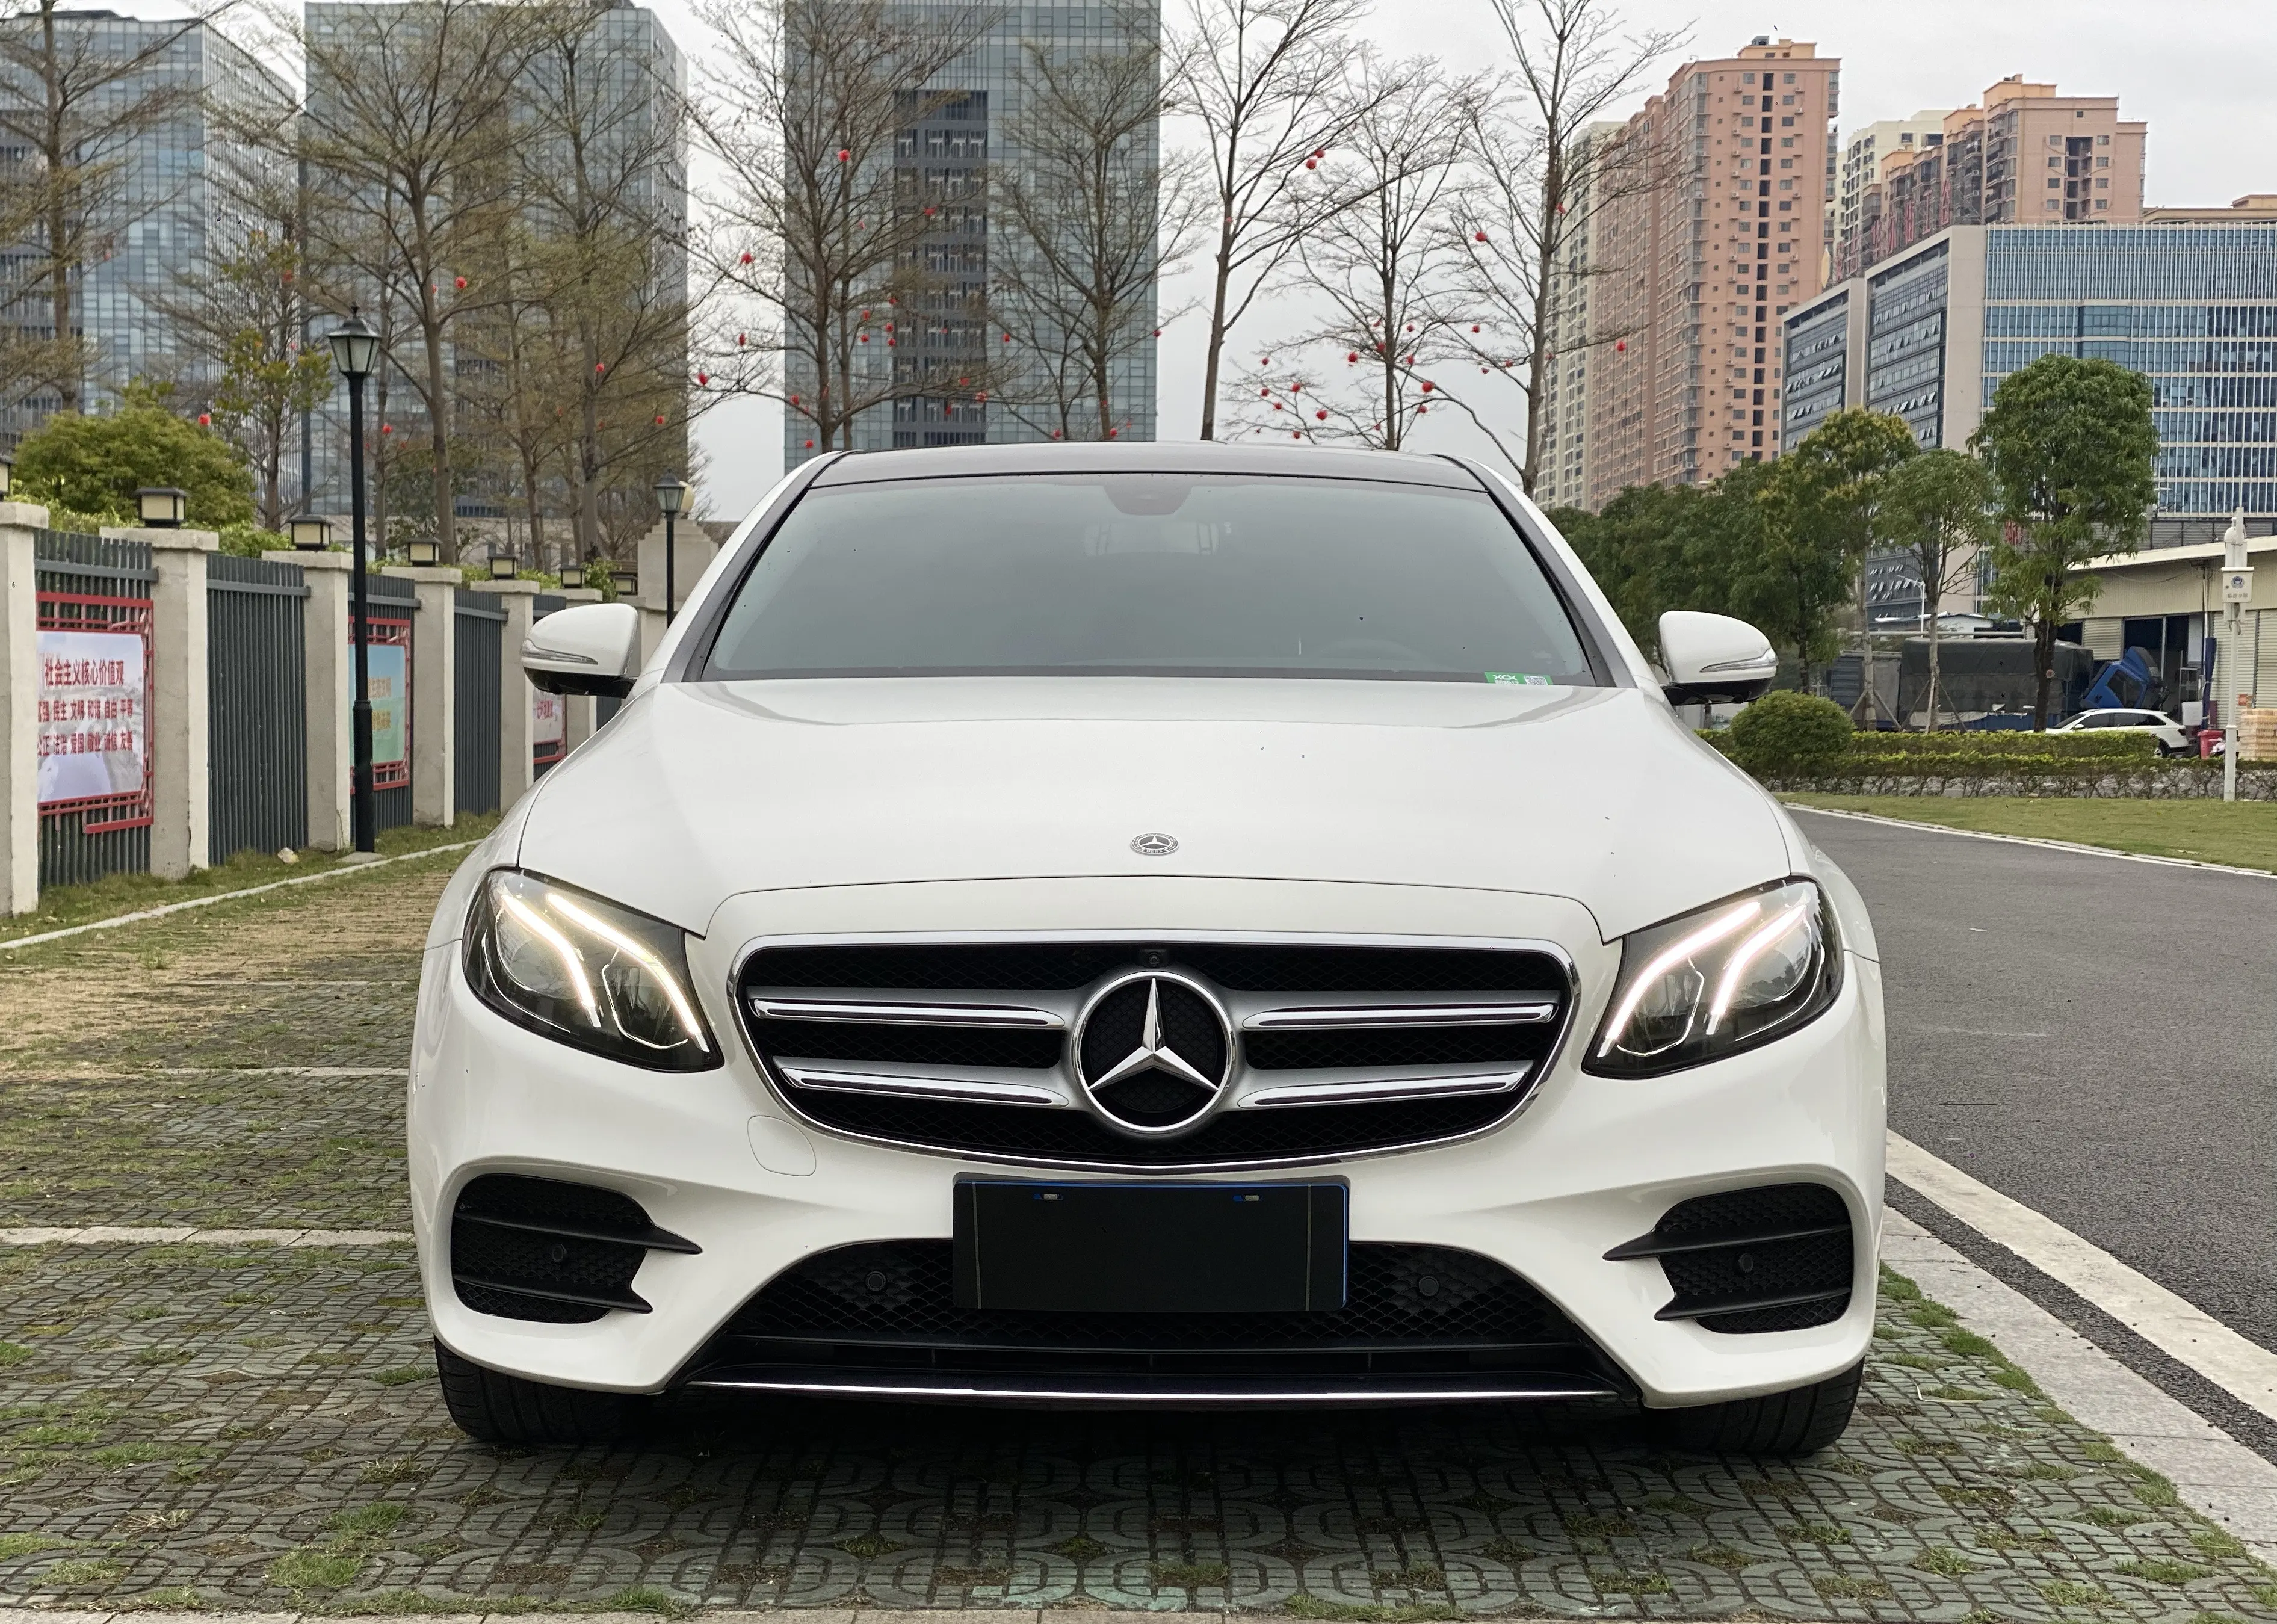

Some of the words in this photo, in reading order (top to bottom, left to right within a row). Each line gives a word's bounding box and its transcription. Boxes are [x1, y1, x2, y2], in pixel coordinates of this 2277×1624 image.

[45, 658, 124, 686] 社会主义核心价值观
[53, 700, 67, 721] 民主
[70, 699, 84, 720] 文明
[88, 698, 101, 720] 和谐
[105, 697, 117, 719] 自由
[120, 698, 133, 718] 平等
[53, 734, 67, 755] 法治
[70, 733, 84, 753] 爱国
[121, 729, 133, 750] 友善
